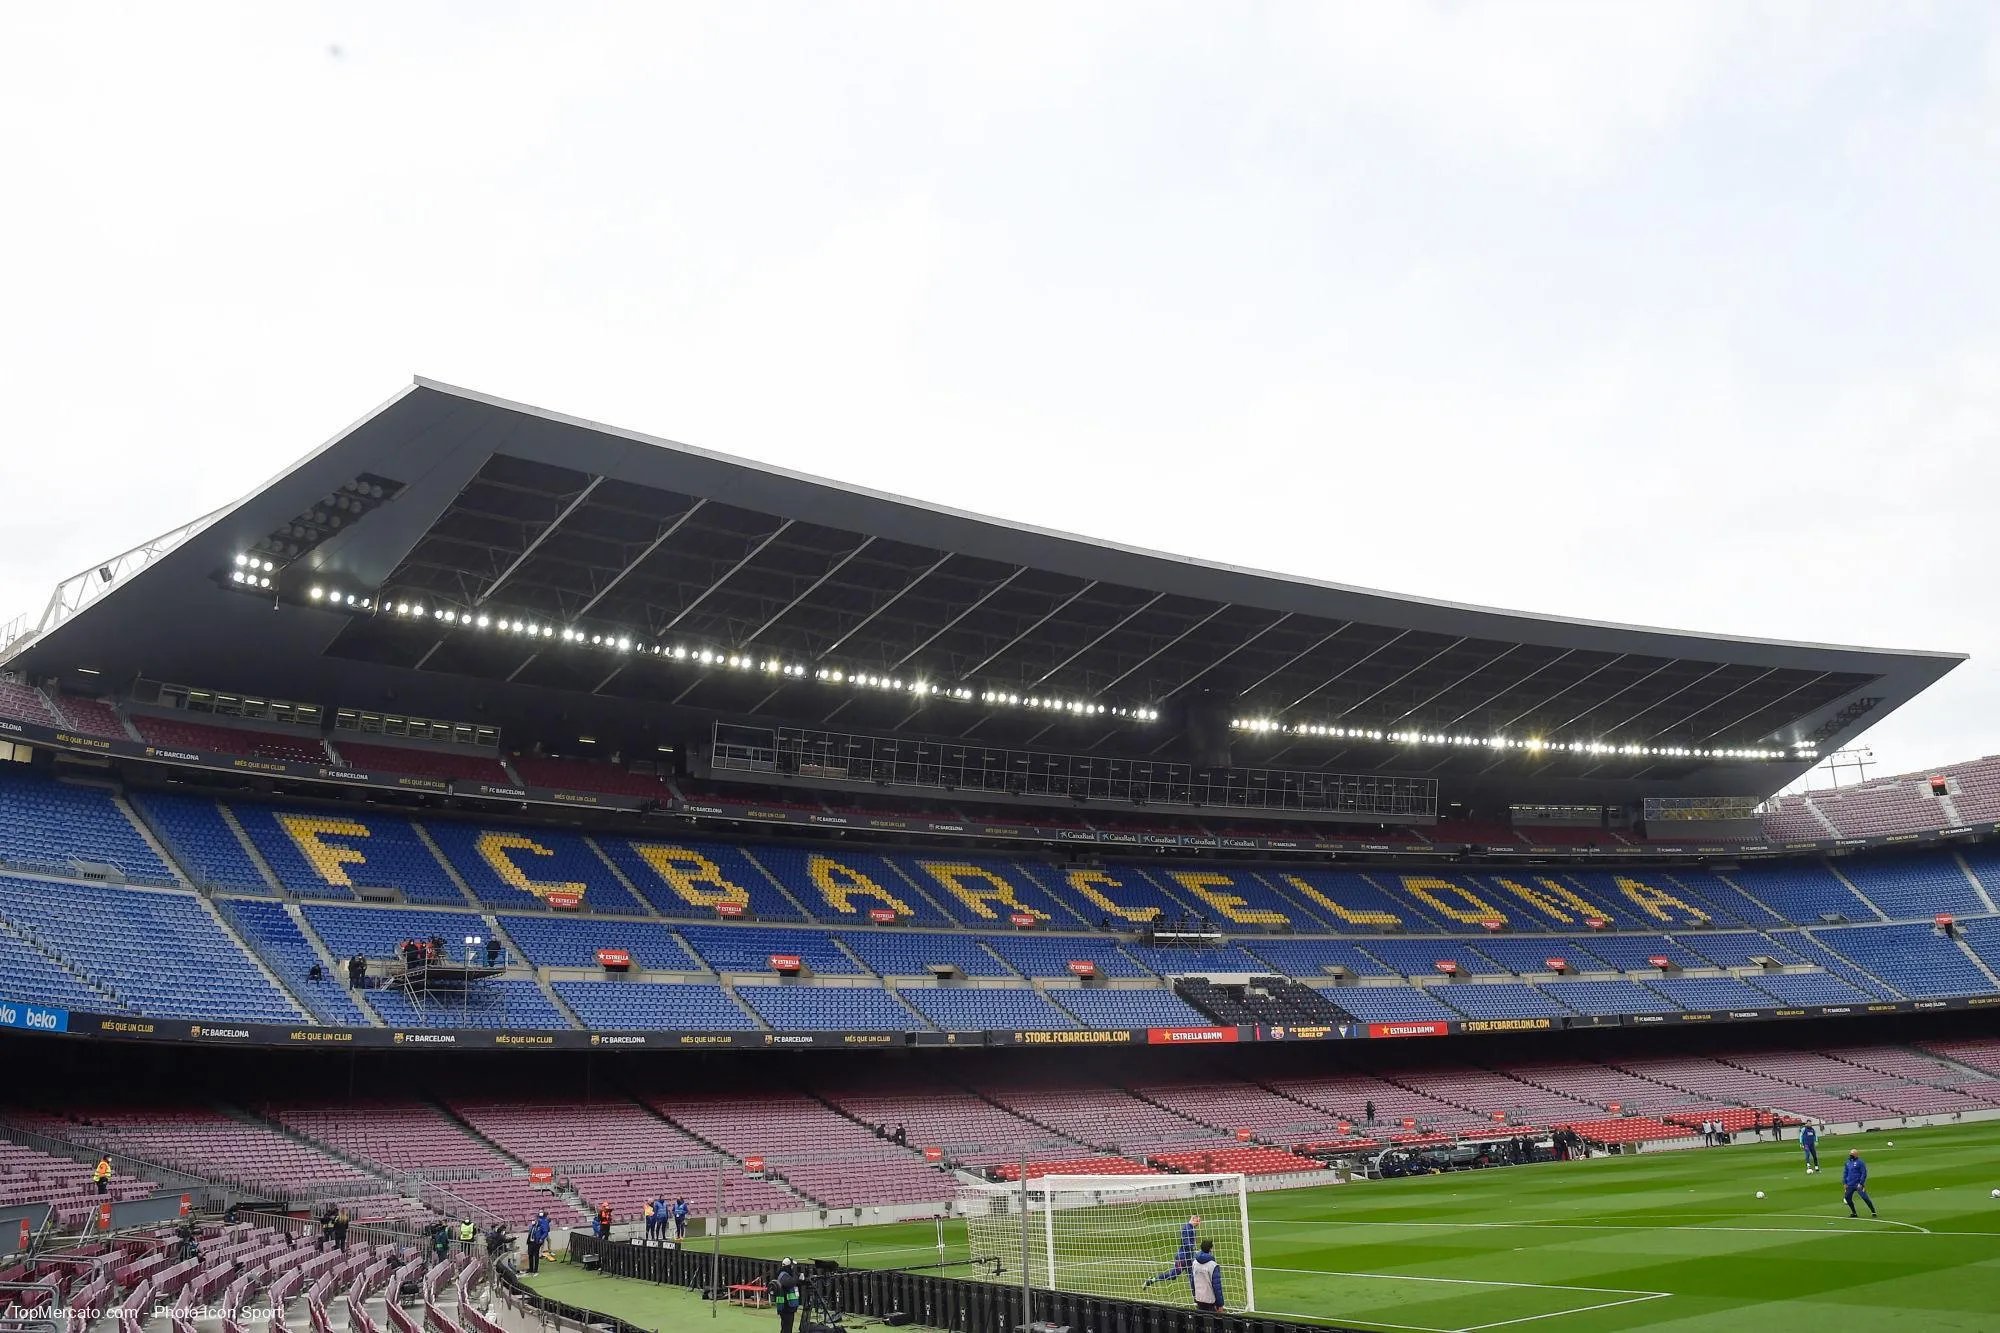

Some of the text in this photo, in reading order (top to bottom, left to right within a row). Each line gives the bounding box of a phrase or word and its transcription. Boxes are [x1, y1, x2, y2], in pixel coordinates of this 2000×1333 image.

[164, 751, 199, 760] BARCELONA
[336, 772, 368, 780] BARCELONA
[1068, 831, 1095, 840] CaixaBank
[1110, 834, 1136, 842] CaixaBank
[1151, 836, 1176, 844] CaixaBank
[27, 1008, 56, 1028] beko
[102, 1019, 154, 1033] MÉS QUE UN CLUB
[1468, 1018, 1550, 1031] STORE.FCBARCELONA.COM
[210, 1029, 249, 1038] BARCELONA
[1390, 1026, 1417, 1034] ESTRELLA
[291, 1031, 306, 1040] MÉS
[307, 1033, 322, 1041] QUE
[496, 1034, 510, 1043] MÉS
[1025, 1031, 1130, 1043] STORE.FCBARCELONA.COM
